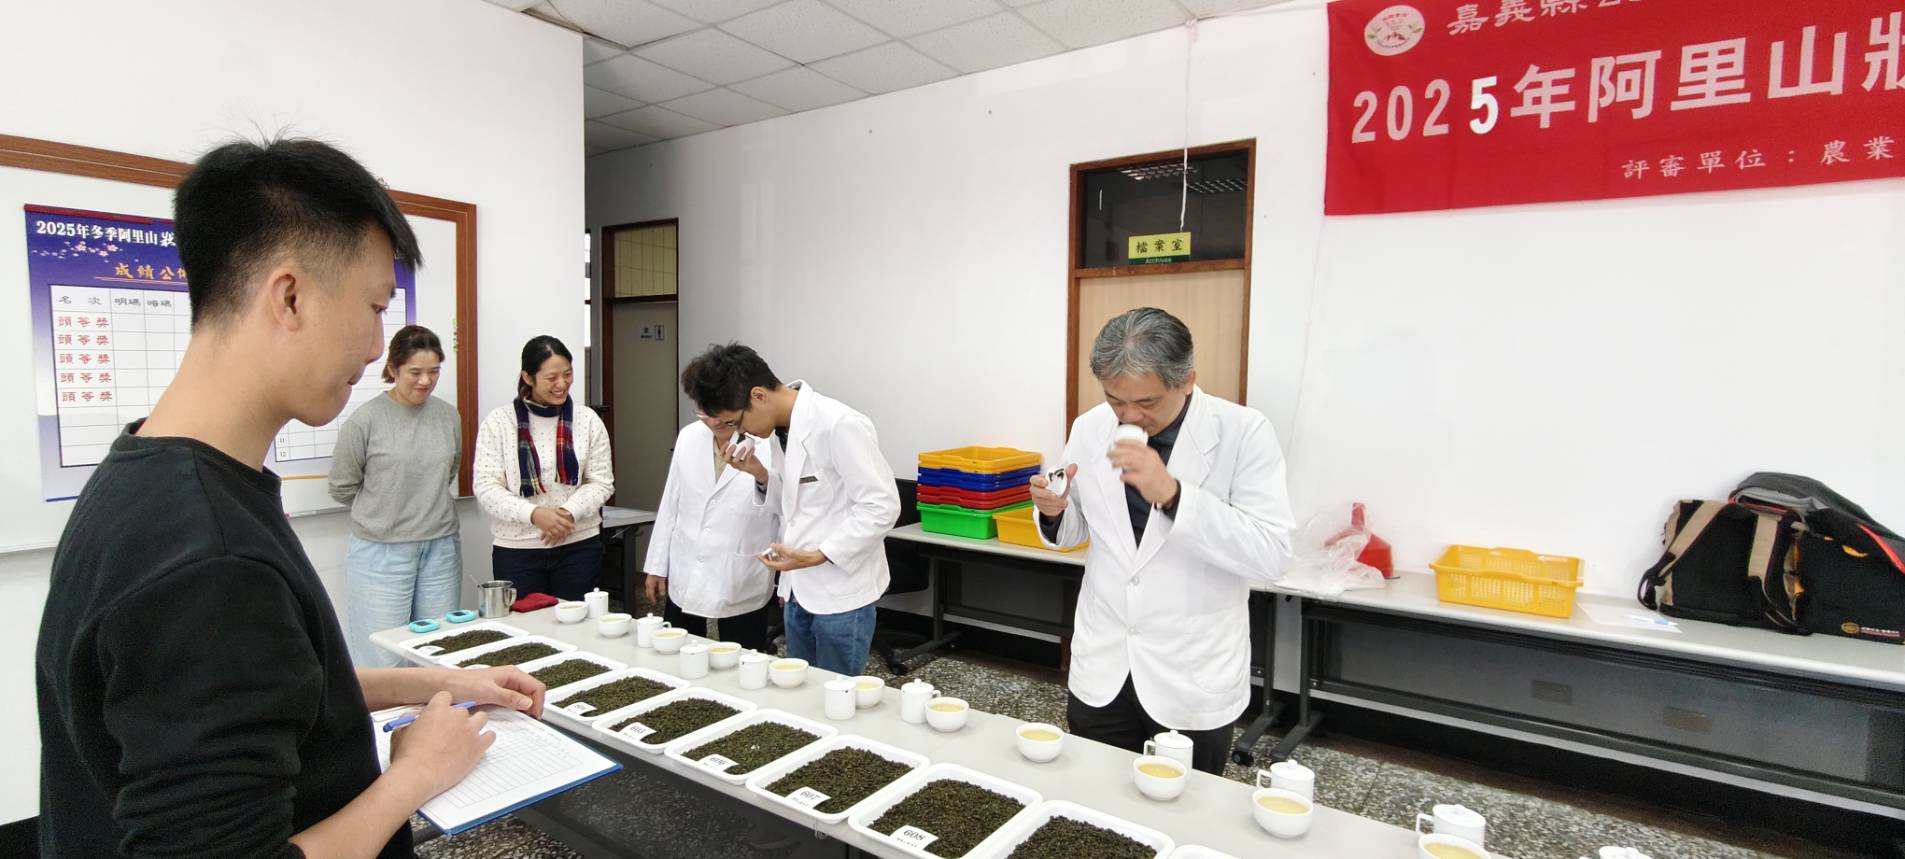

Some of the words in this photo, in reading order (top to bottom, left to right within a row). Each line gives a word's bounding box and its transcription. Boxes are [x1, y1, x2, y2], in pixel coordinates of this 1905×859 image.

[1136, 238, 1183, 254] 檔案室
[903, 829, 926, 841] 608
